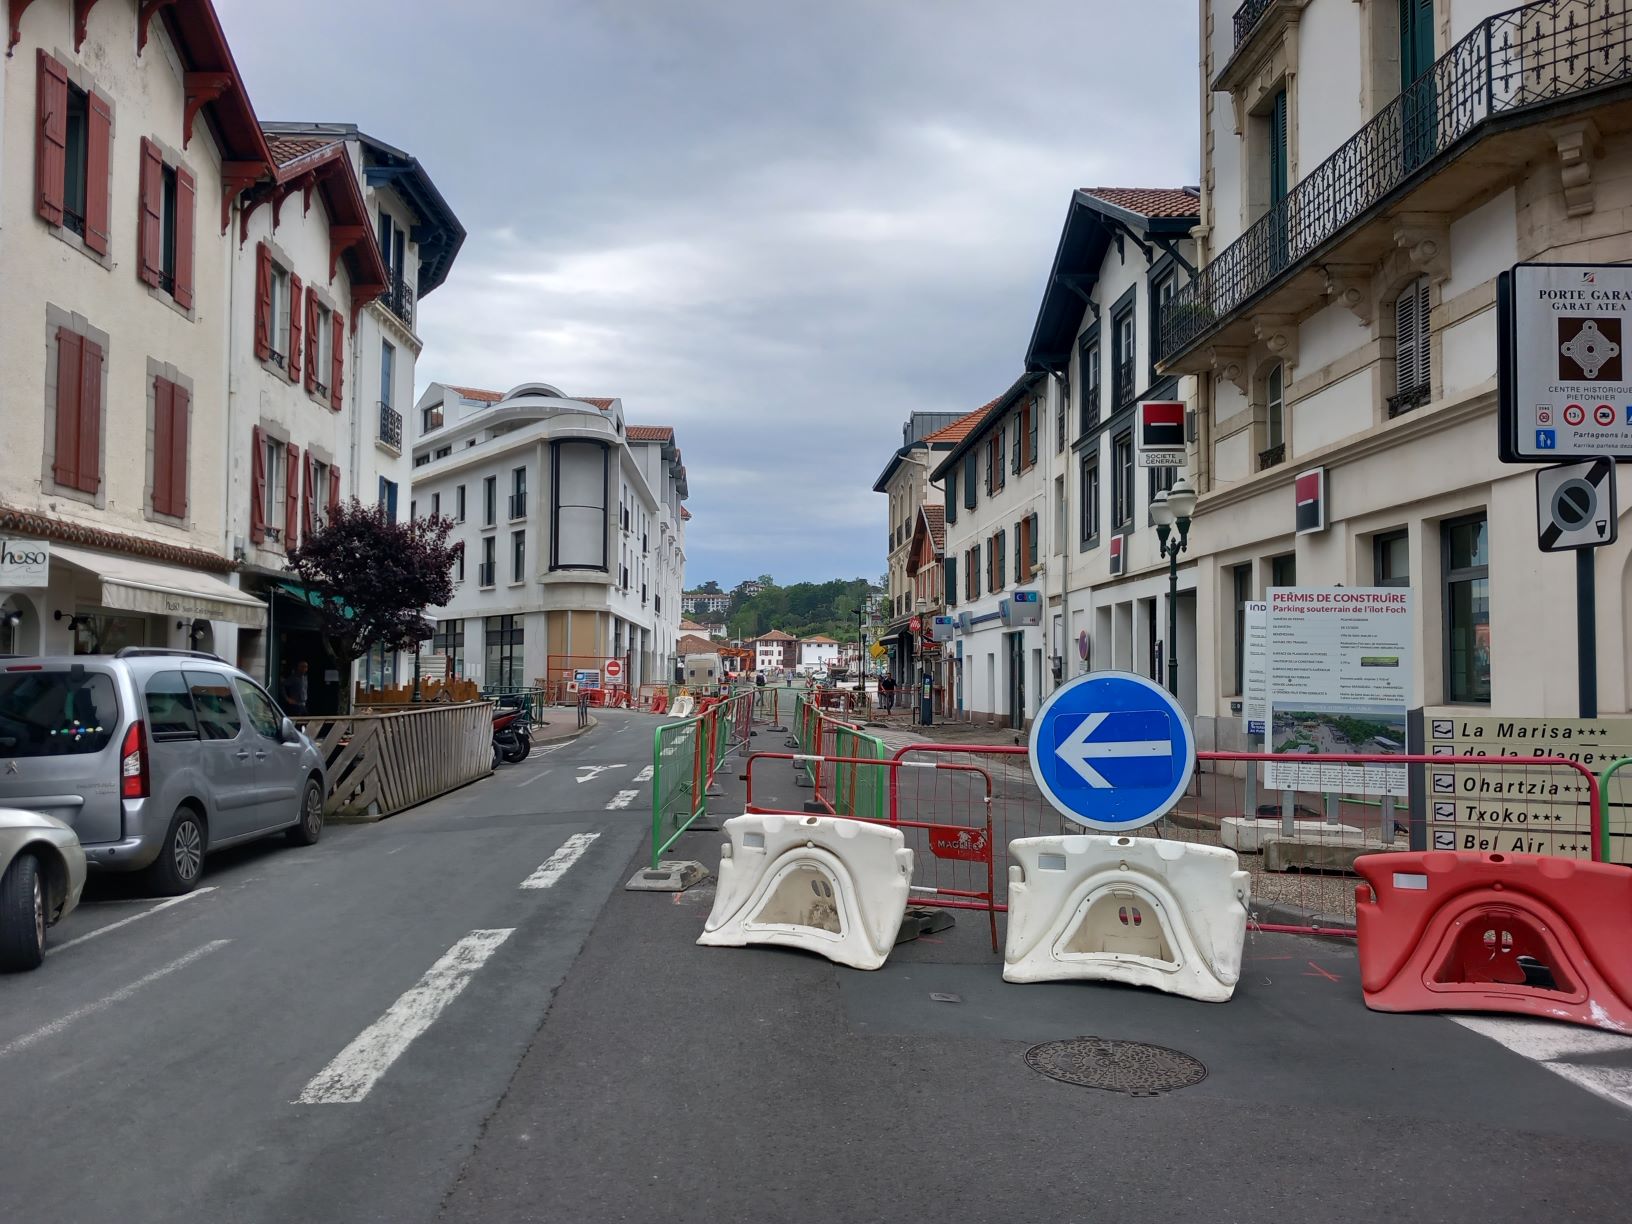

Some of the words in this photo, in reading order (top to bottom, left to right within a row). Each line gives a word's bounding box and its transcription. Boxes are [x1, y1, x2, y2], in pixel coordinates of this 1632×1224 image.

[1539, 289, 1586, 300] PORTE
[1591, 289, 1632, 300] GARA
[1552, 302, 1592, 311] GARAT
[1596, 302, 1626, 311] ATEA
[1573, 431, 1619, 439] Partageons
[1, 541, 46, 565] hoso
[1273, 593, 1315, 603] PERMIS
[1317, 593, 1331, 603] DE
[1273, 605, 1305, 614] Parking
[1306, 605, 1350, 613] souterrain
[1352, 605, 1363, 613] de
[1385, 605, 1407, 614] Foch
[1461, 722, 1483, 737] La
[1497, 723, 1573, 739] Marisa
[1463, 777, 1559, 795] Ohartzia
[1465, 805, 1528, 823] Txoko
[1463, 834, 1499, 851] Bel
[1511, 837, 1545, 853] Air
